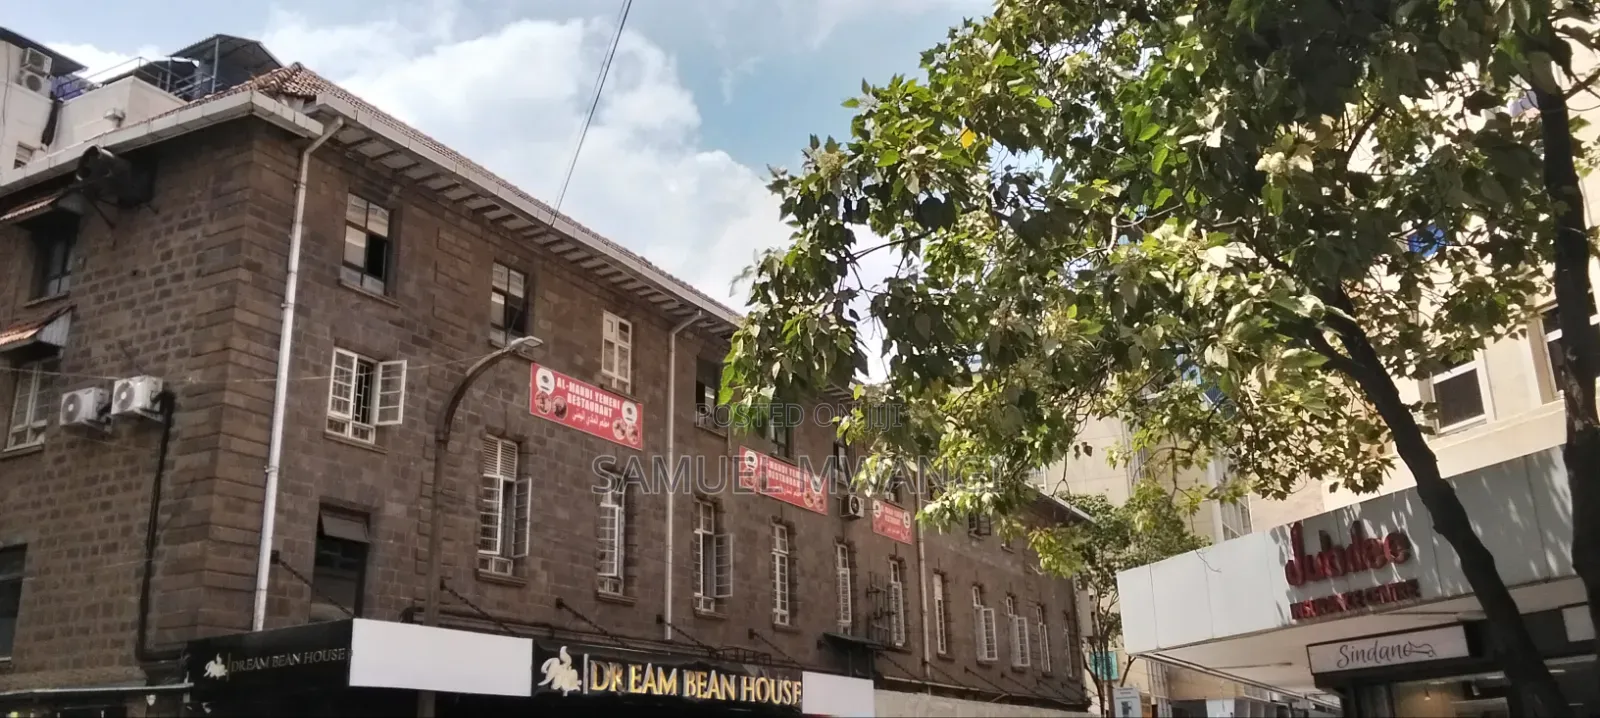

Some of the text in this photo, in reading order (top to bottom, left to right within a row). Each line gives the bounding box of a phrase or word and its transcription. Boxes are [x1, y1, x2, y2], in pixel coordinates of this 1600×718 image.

[557, 377, 621, 410] AL-MANDI YEMENI
[567, 392, 613, 418] RESTAURANT
[231, 647, 346, 672] DREAM BEAN HOUSE
[1337, 639, 1416, 668] Sindano
[683, 669, 737, 701] BEAN
[740, 674, 803, 705] HOUSE
